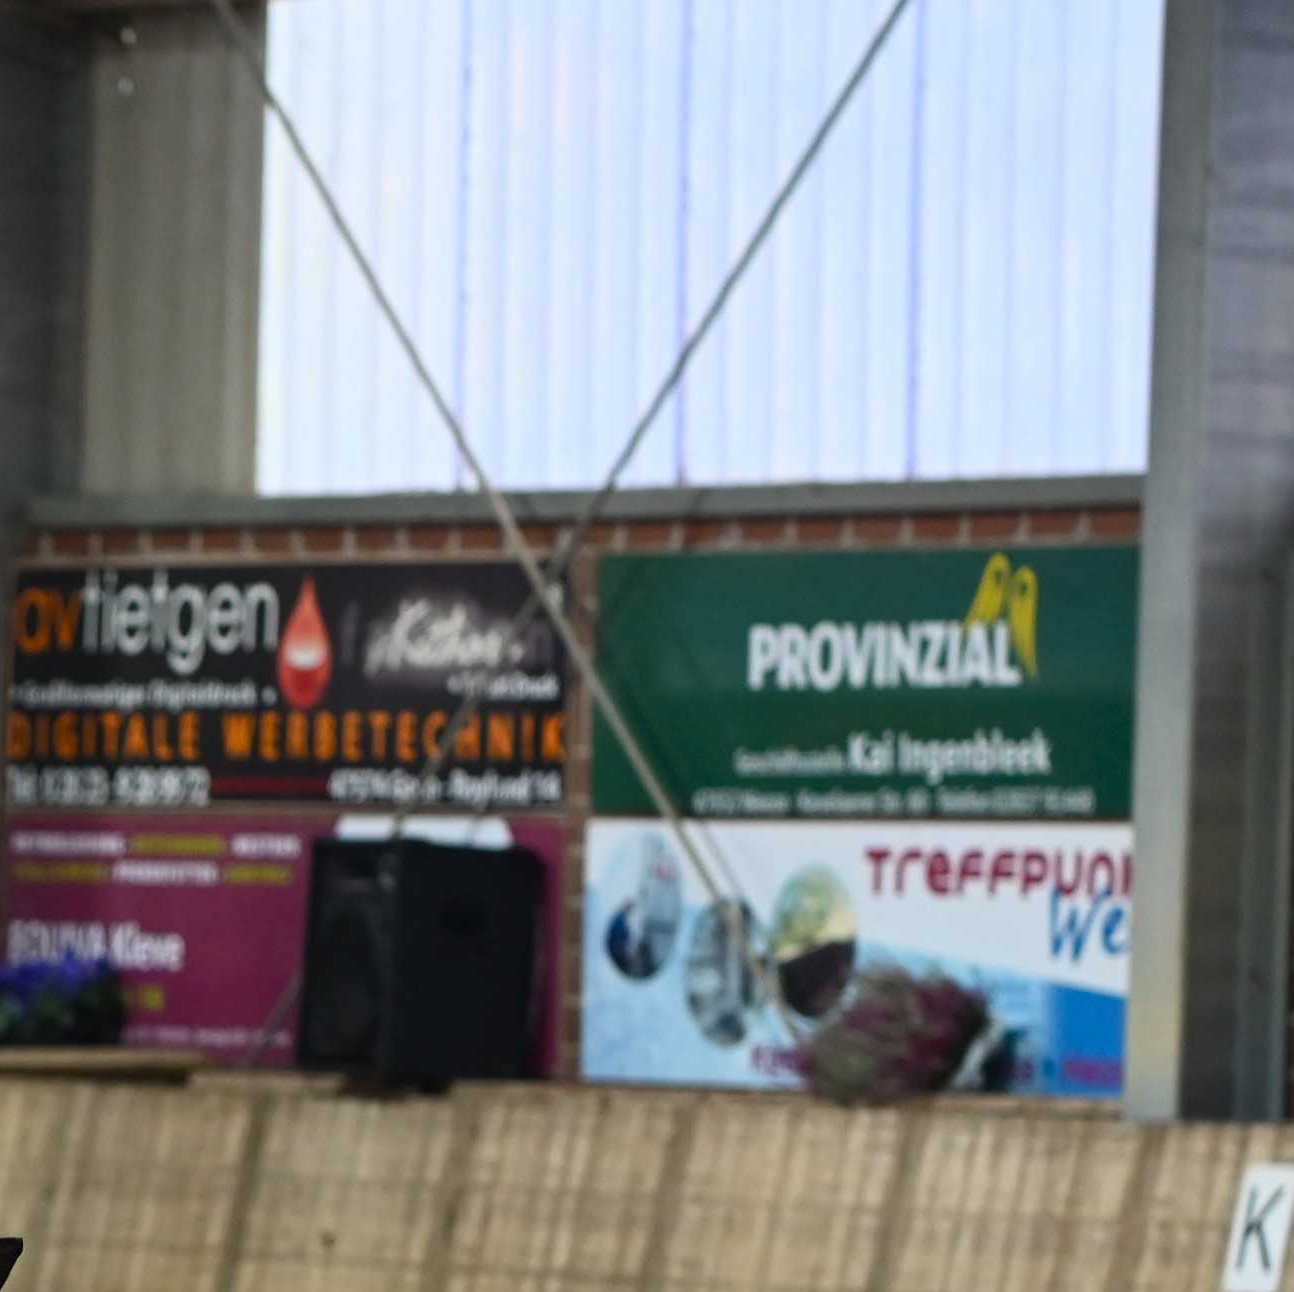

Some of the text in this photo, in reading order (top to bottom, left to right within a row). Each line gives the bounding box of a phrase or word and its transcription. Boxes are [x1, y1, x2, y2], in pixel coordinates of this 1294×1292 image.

[746, 620, 1022, 692] PROVINZIAL
[6, 709, 202, 761] DIGITALE
[847, 731, 895, 775] Kai
[1235, 1183, 1288, 1271] K
